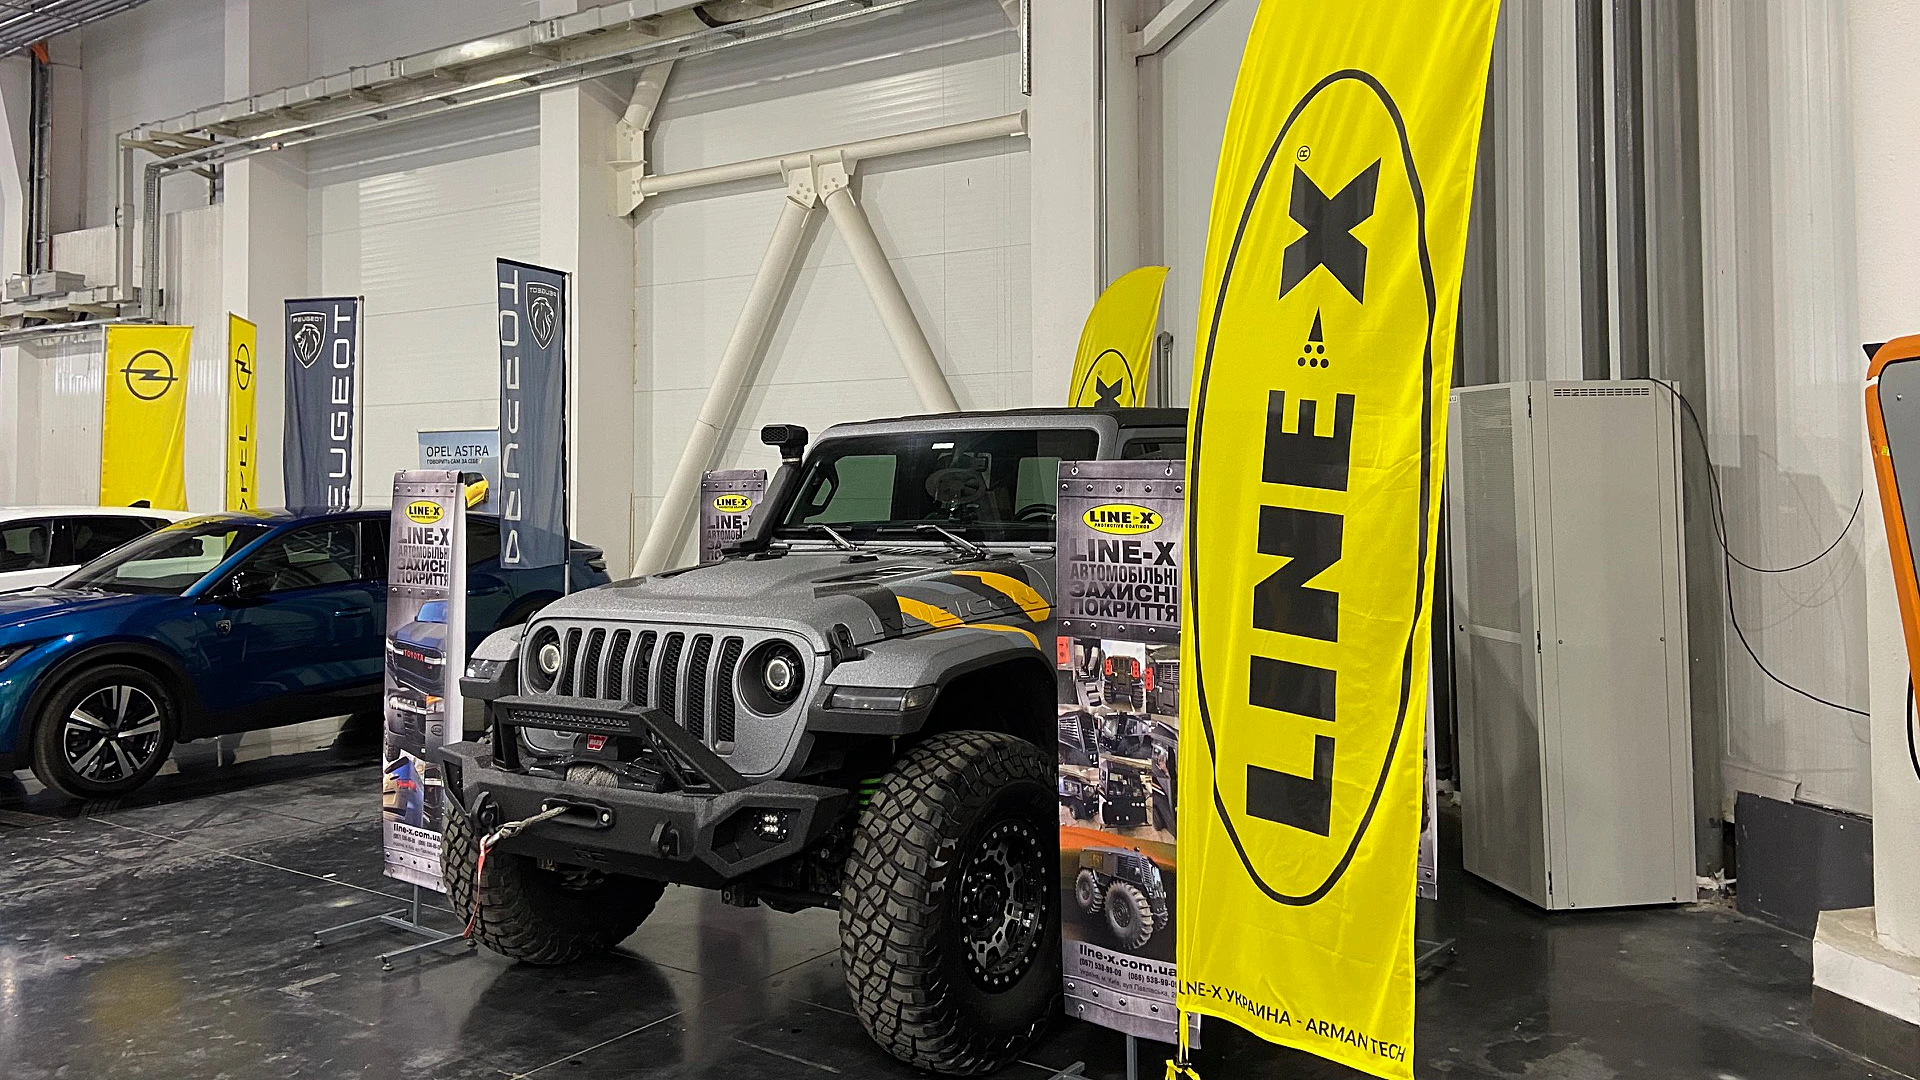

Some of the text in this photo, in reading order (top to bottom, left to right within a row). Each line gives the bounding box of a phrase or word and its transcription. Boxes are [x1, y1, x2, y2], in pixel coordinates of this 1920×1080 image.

[293, 315, 323, 323] PEUGEOT
[327, 304, 351, 507] EUGEOT
[426, 445, 489, 457] OPEL ASTRA
[409, 506, 440, 515] LINE-X
[707, 515, 752, 529] LINE-
[1089, 511, 1155, 525] LINE-X
[397, 527, 450, 546] LINE-X
[1069, 538, 1176, 566] LINE-X
[1069, 563, 1178, 586] АВТОМОБІЛЬНІ
[1069, 581, 1178, 605] ЗАХИСНІ
[1069, 599, 1178, 623] ПОКРИТТЯ
[1079, 944, 1177, 977] line-x.com.ua
[1224, 987, 1292, 1027] УКРАИНА
